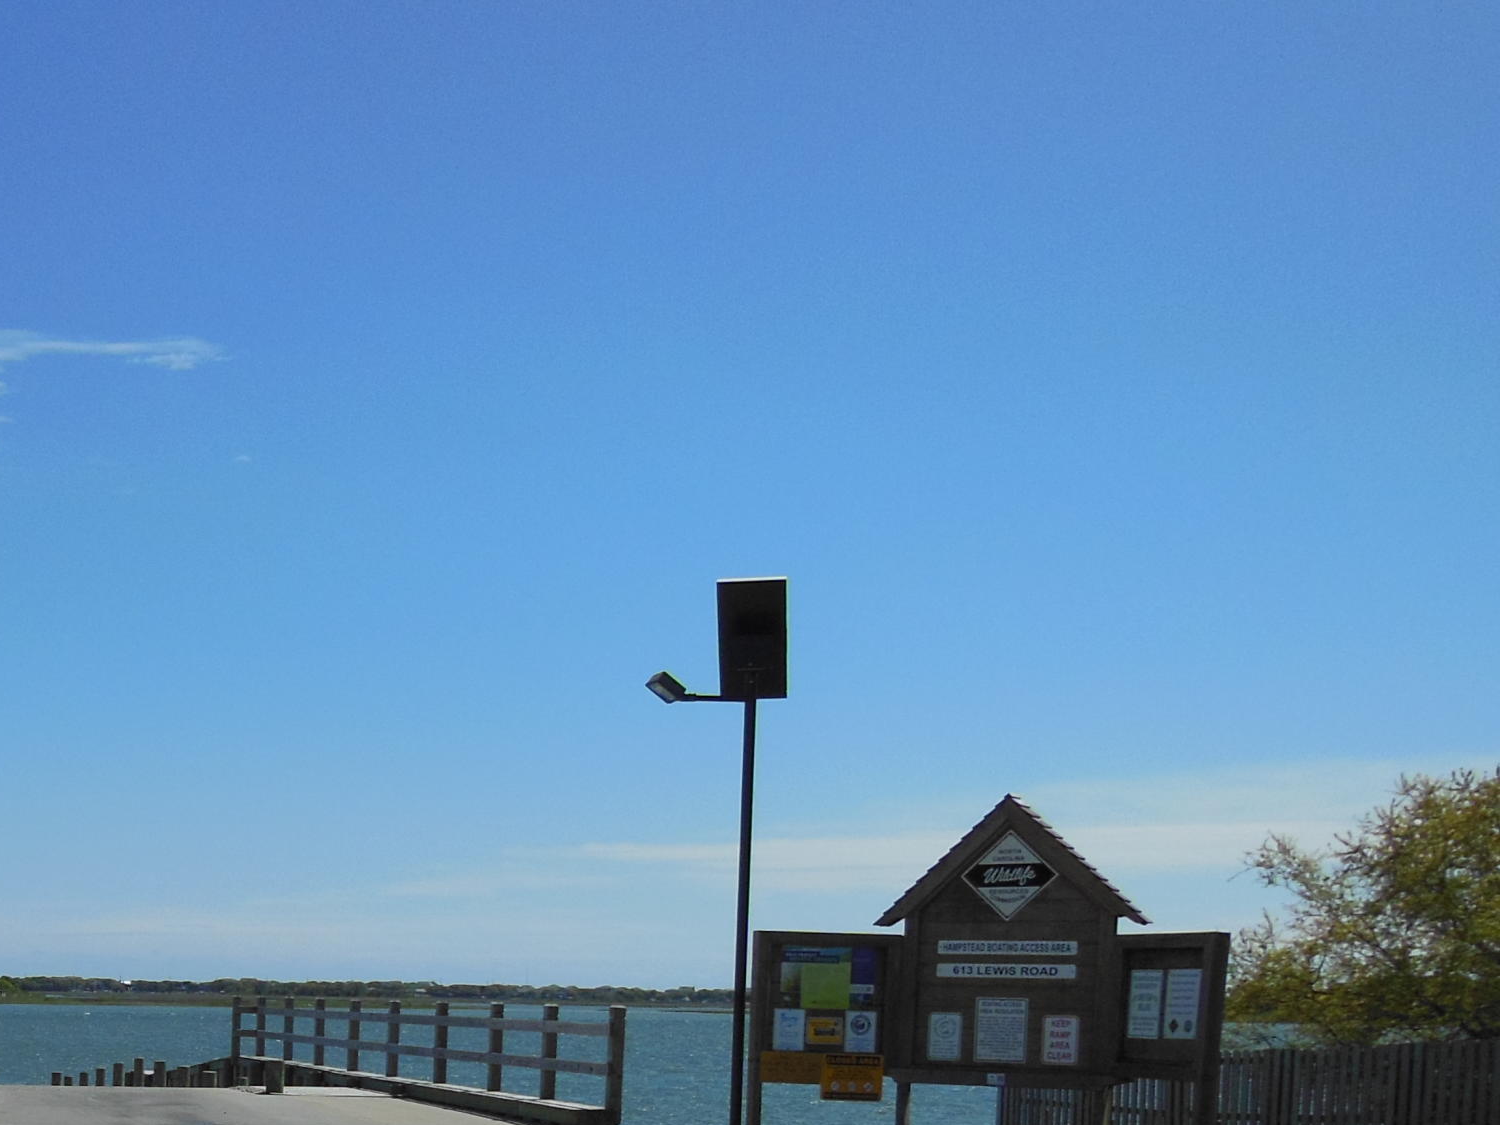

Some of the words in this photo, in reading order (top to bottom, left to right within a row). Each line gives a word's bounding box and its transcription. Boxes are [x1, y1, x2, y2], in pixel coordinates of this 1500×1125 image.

[983, 865, 1036, 885] Wildlife
[943, 943, 985, 952] HAMPSTEAD
[987, 943, 1018, 952] BOATING
[1020, 943, 1049, 952] ACCESS
[1051, 944, 1072, 952] AREA
[953, 966, 973, 975] 613
[977, 966, 1016, 975] LEWIS
[1020, 967, 1058, 976] ROAD
[1050, 1041, 1070, 1049] AREA
[1047, 1051, 1072, 1060] CLEAR
